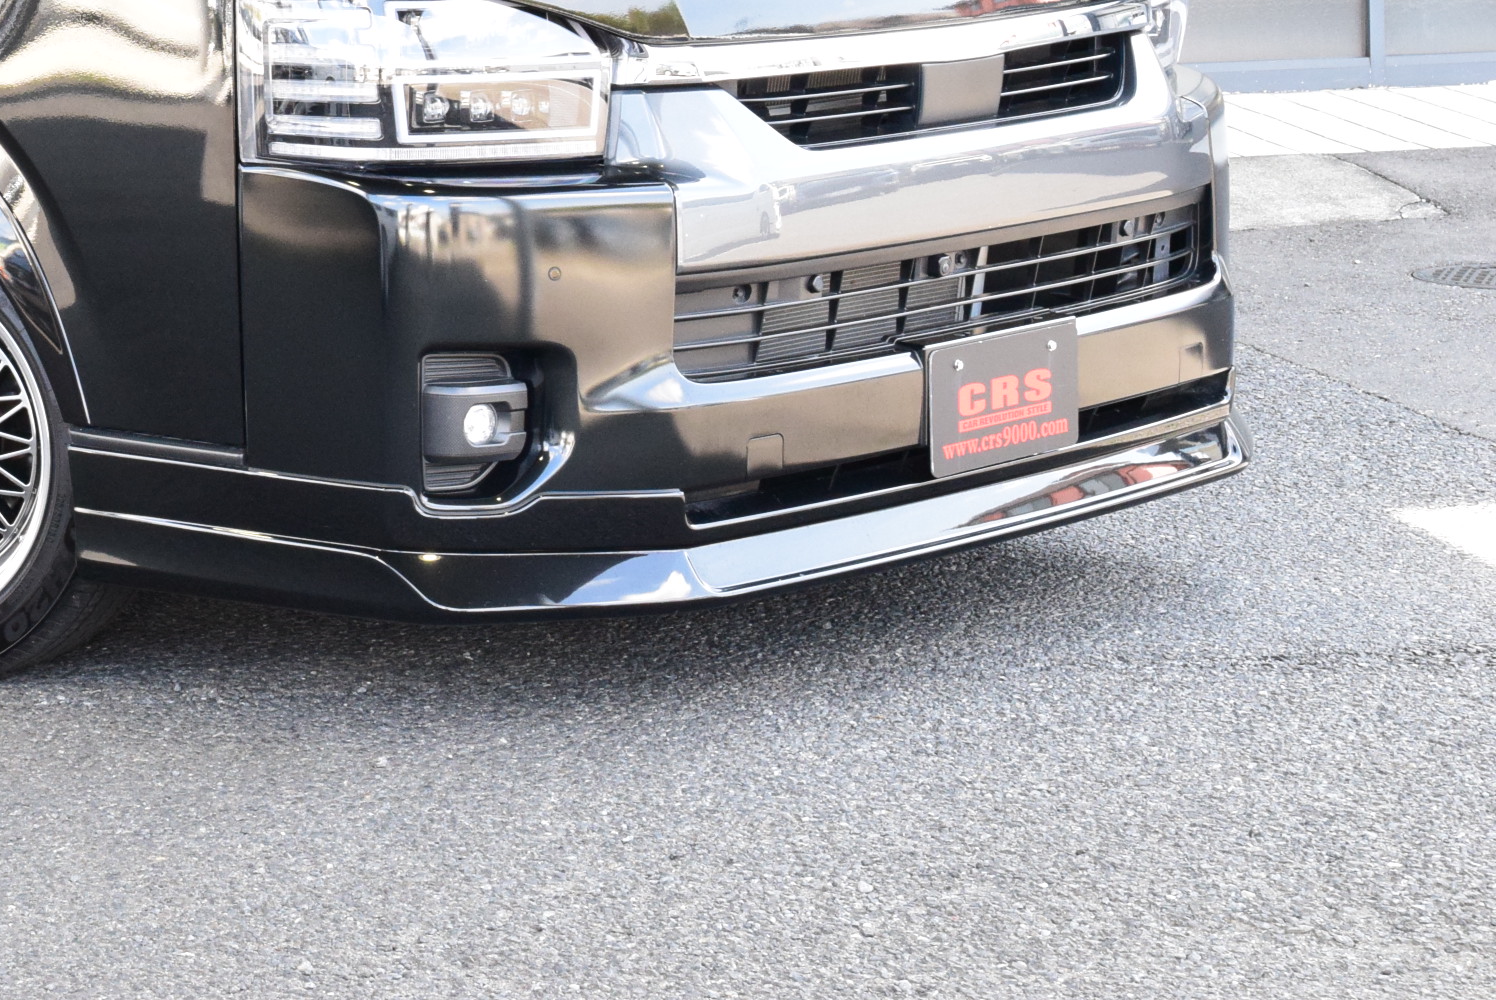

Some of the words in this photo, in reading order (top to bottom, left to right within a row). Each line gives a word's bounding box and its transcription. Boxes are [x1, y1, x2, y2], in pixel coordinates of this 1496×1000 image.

[958, 368, 1052, 416] CRS
[963, 420, 977, 429] CAR
[979, 409, 1025, 425] REVOLUTION
[1028, 404, 1049, 415] STYLE
[942, 418, 1069, 460] www.crs9000.com
